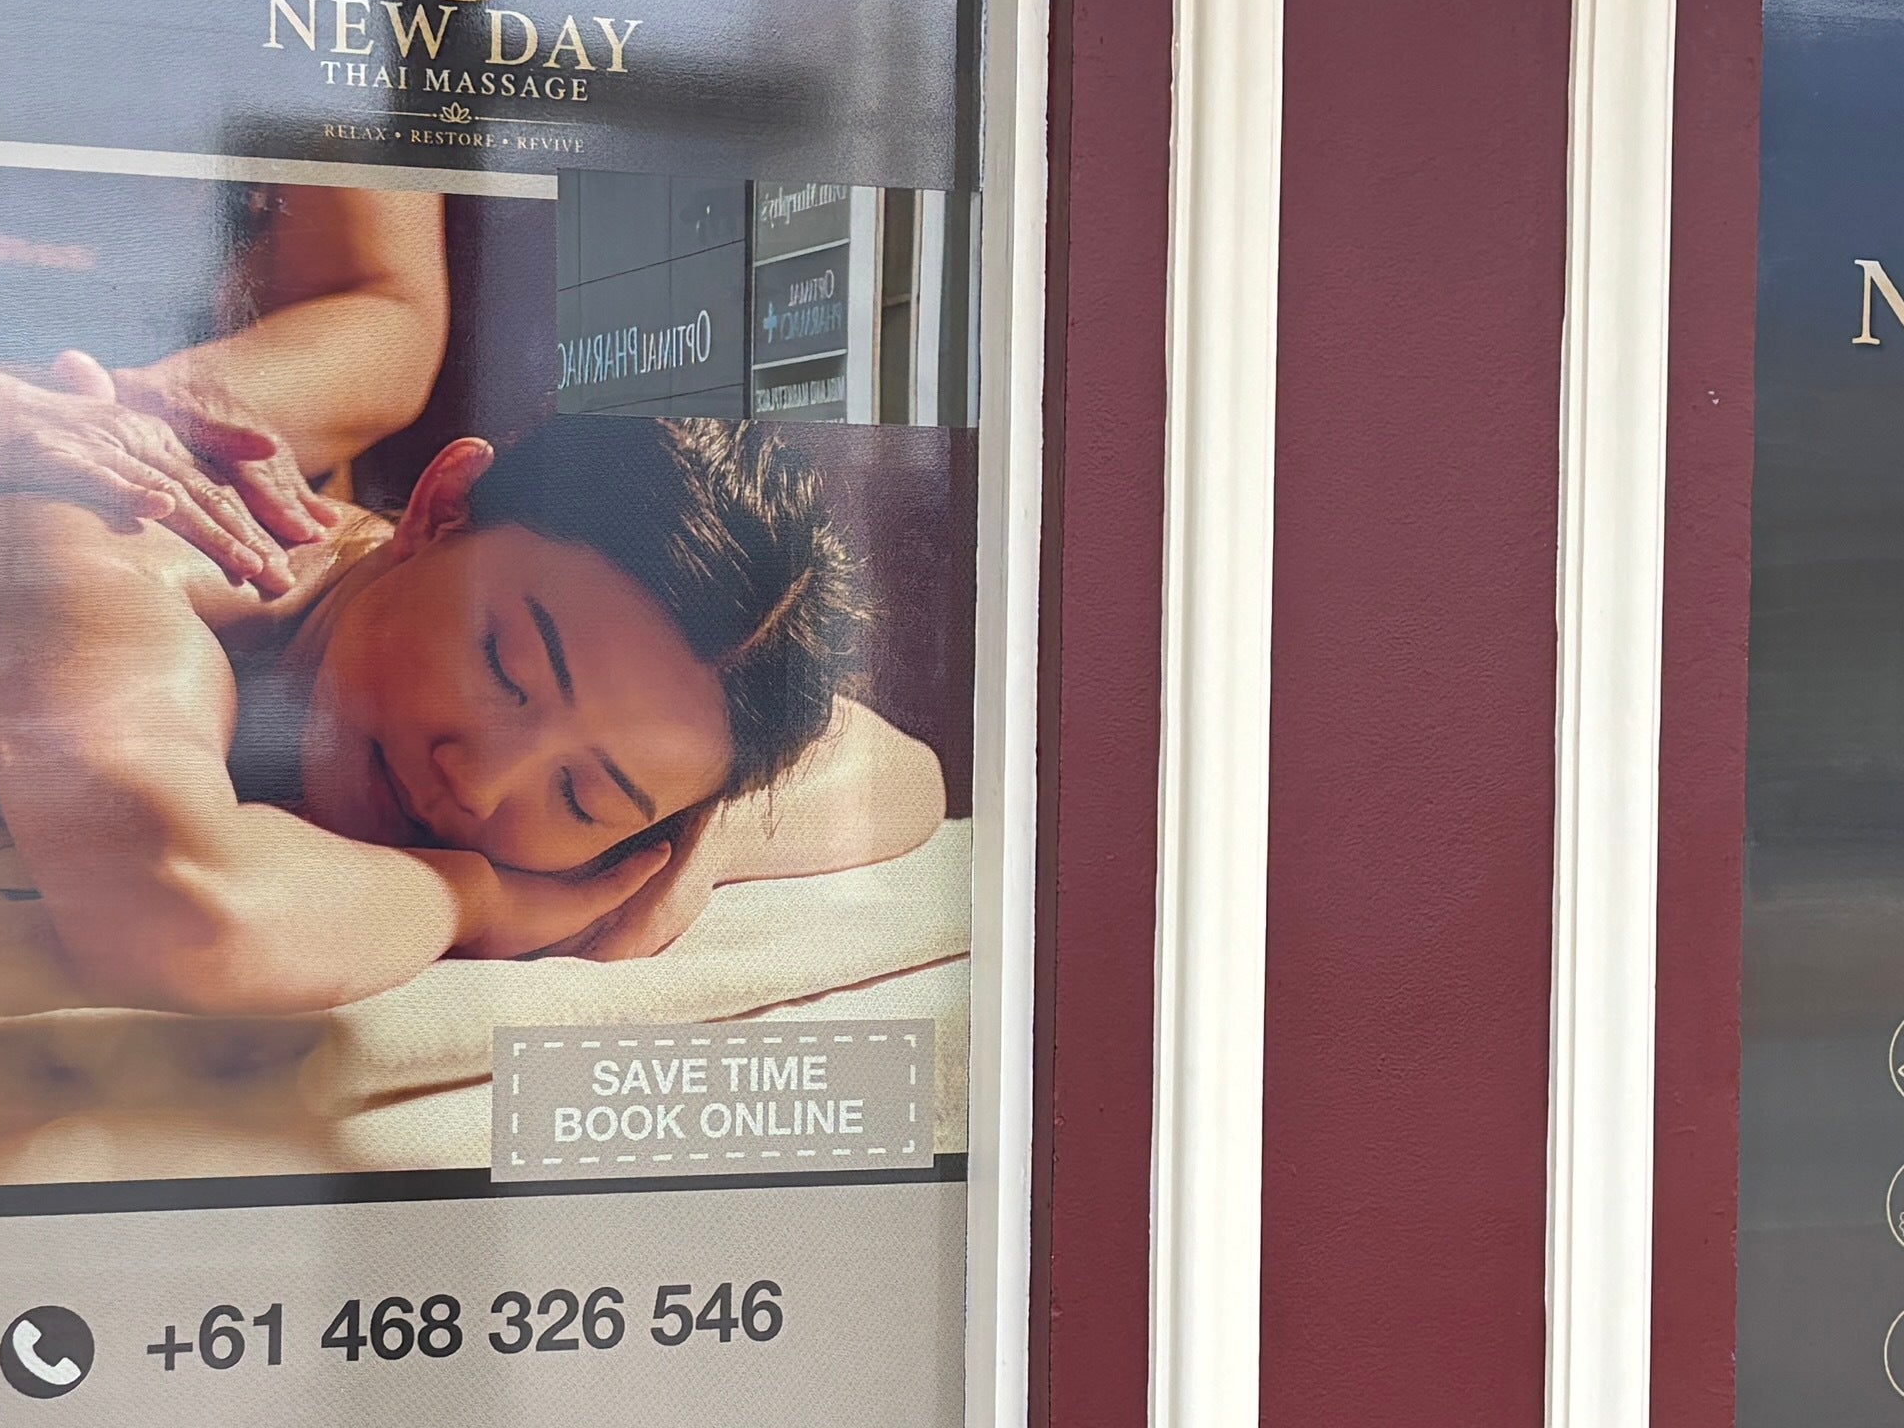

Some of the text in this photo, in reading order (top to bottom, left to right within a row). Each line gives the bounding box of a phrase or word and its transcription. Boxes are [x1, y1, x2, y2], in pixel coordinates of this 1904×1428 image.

[485, 9, 643, 73] DAY
[320, 61, 588, 101] THAI MASSAGE
[324, 124, 585, 153] RELAX RESTORE REVIVE
[592, 1056, 827, 1096] SAVE TIME
[555, 1099, 864, 1142] BOOK ONLINE
[147, 1280, 783, 1371] +61 468 326 546
